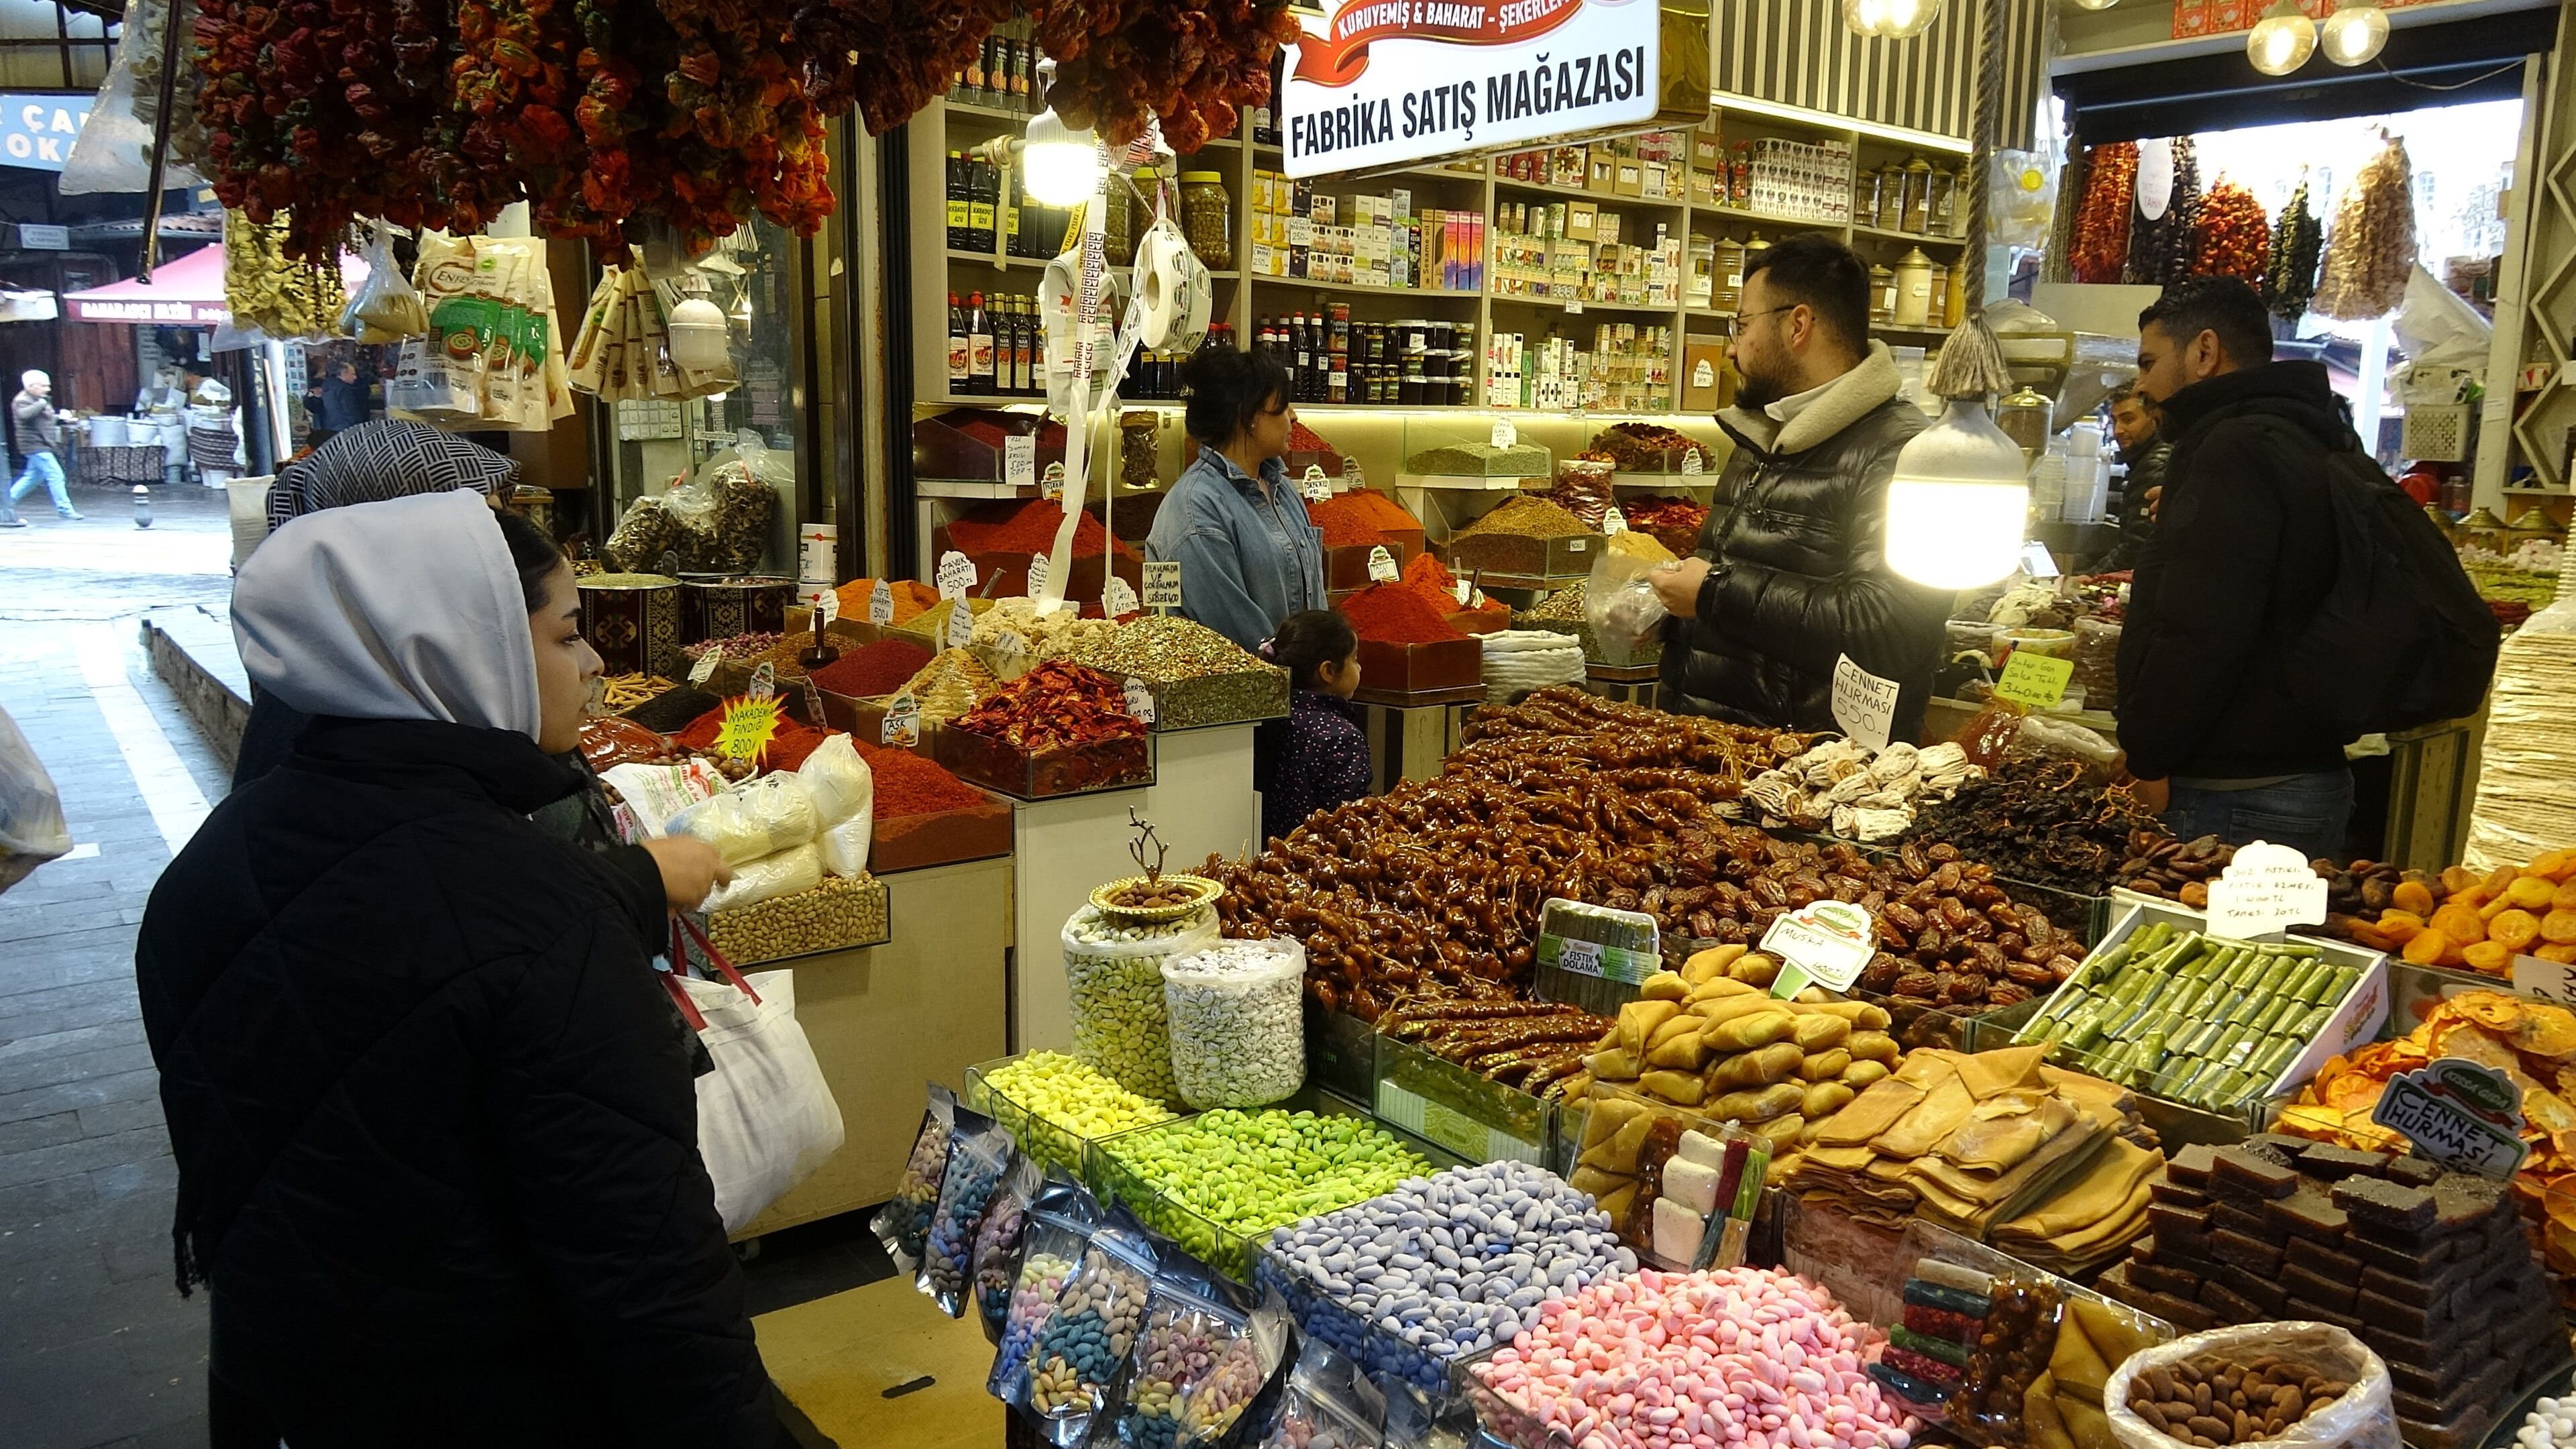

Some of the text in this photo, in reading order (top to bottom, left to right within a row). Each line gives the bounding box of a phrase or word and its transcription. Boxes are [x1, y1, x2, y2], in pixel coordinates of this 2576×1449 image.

[1413, 7, 1423, 23] &
[1426, 6, 1485, 30] BAHARAT
[1292, 46, 1645, 158] FABRİKA SATIŞ MAĞAZASI
[938, 565, 971, 582] BAHARATI
[941, 557, 967, 572] TAVUK
[1839, 661, 1896, 698] CENNET
[1835, 678, 1891, 715] HURMASI
[1563, 959, 1599, 973] DOLAMA
[1570, 951, 1593, 964] FISTIK
[2400, 1089, 2498, 1150] CENNET
[2389, 1104, 2494, 1167] HURMASI
